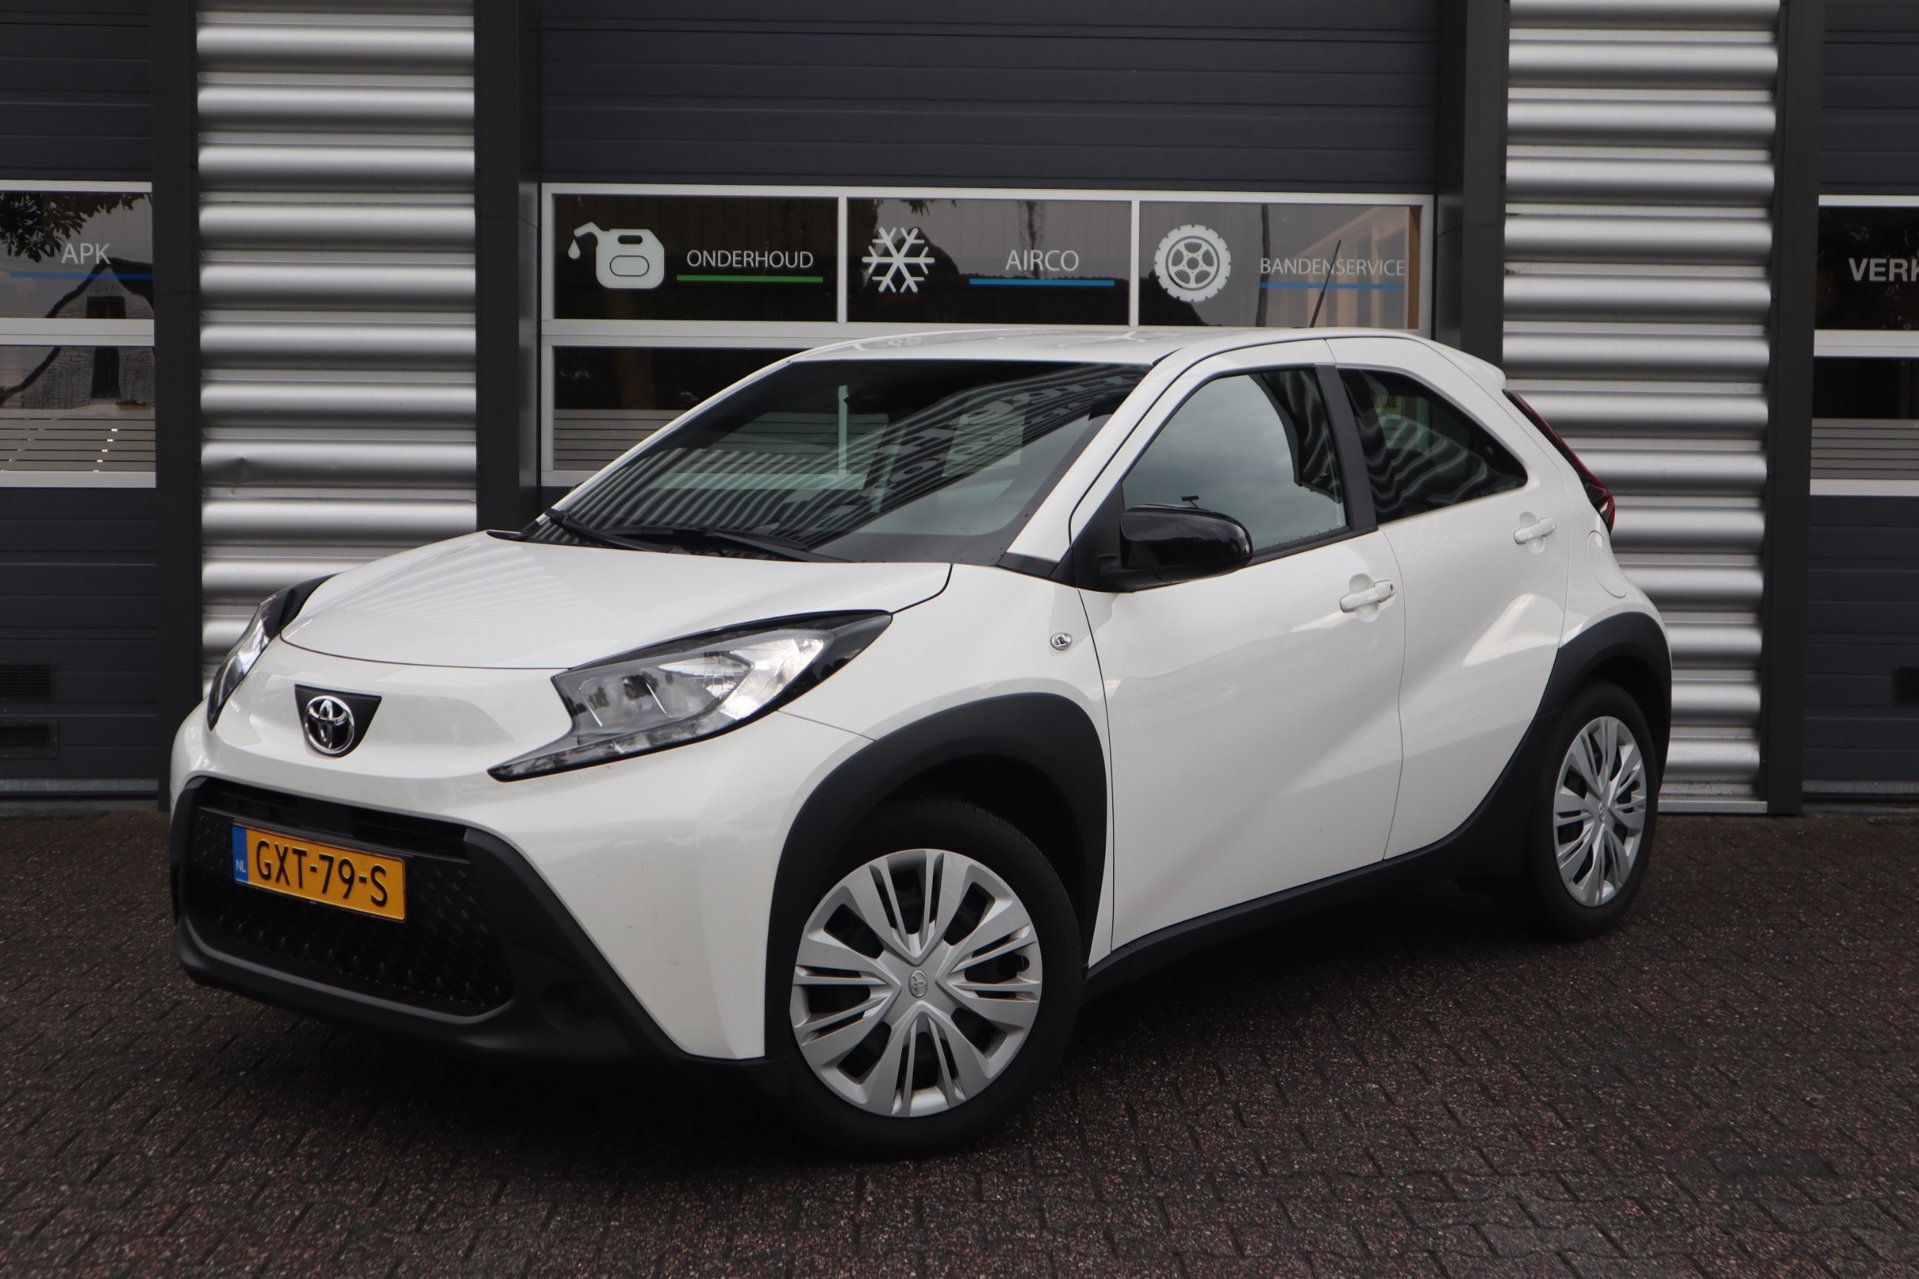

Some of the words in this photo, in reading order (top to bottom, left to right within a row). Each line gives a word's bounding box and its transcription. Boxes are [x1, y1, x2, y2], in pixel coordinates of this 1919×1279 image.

[61, 242, 111, 265] APK
[686, 249, 814, 269] ONDERHOUD
[1005, 249, 1080, 272] AIRCO
[1260, 257, 1406, 276] BANDENSERVICE
[235, 859, 247, 873] NL
[256, 839, 388, 908] GXT-79-S
